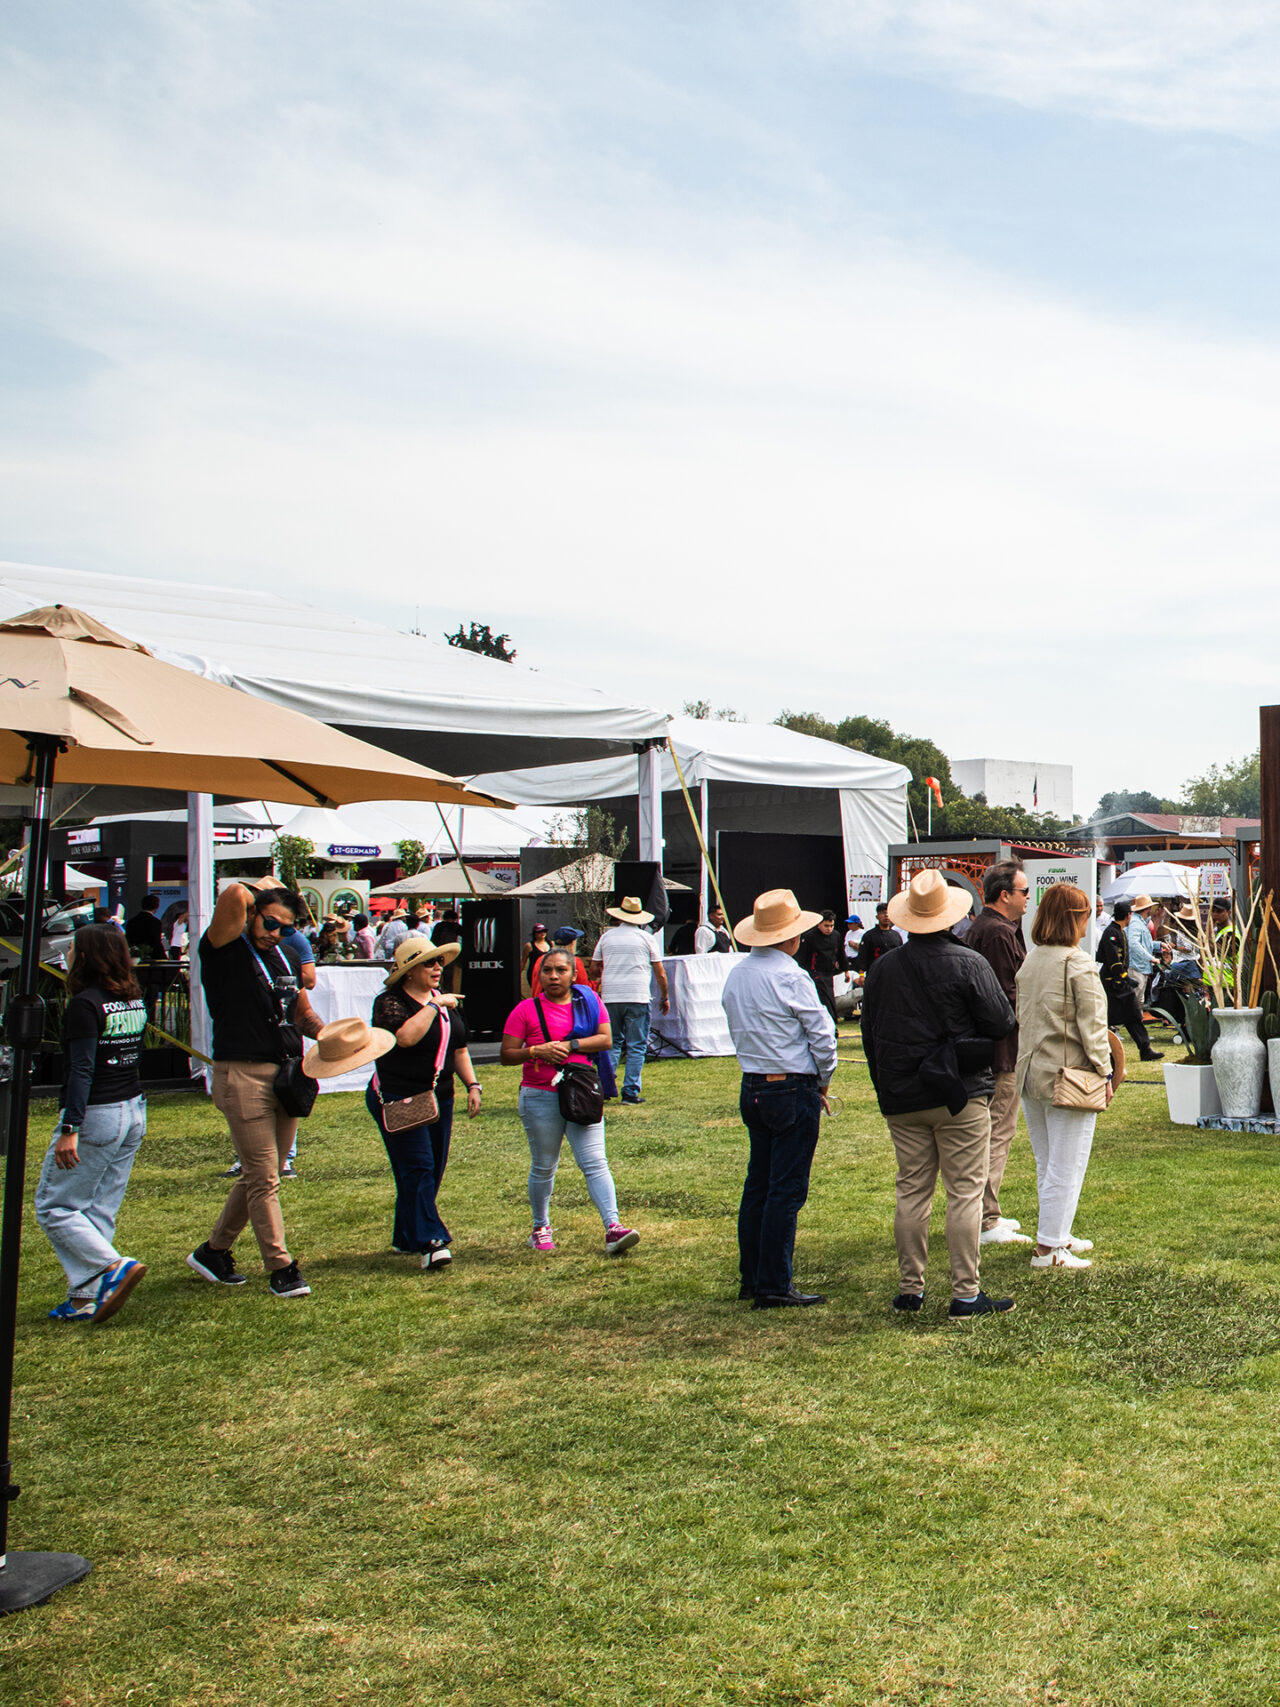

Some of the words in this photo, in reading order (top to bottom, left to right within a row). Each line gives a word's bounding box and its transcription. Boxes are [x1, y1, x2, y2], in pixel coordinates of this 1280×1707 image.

[334, 847, 376, 855] ST-GERMAIN
[1036, 876, 1055, 885] FOOD
[1059, 876, 1078, 884] WINE
[469, 960, 504, 969] BUICK
[102, 1001, 125, 1013] FOOD
